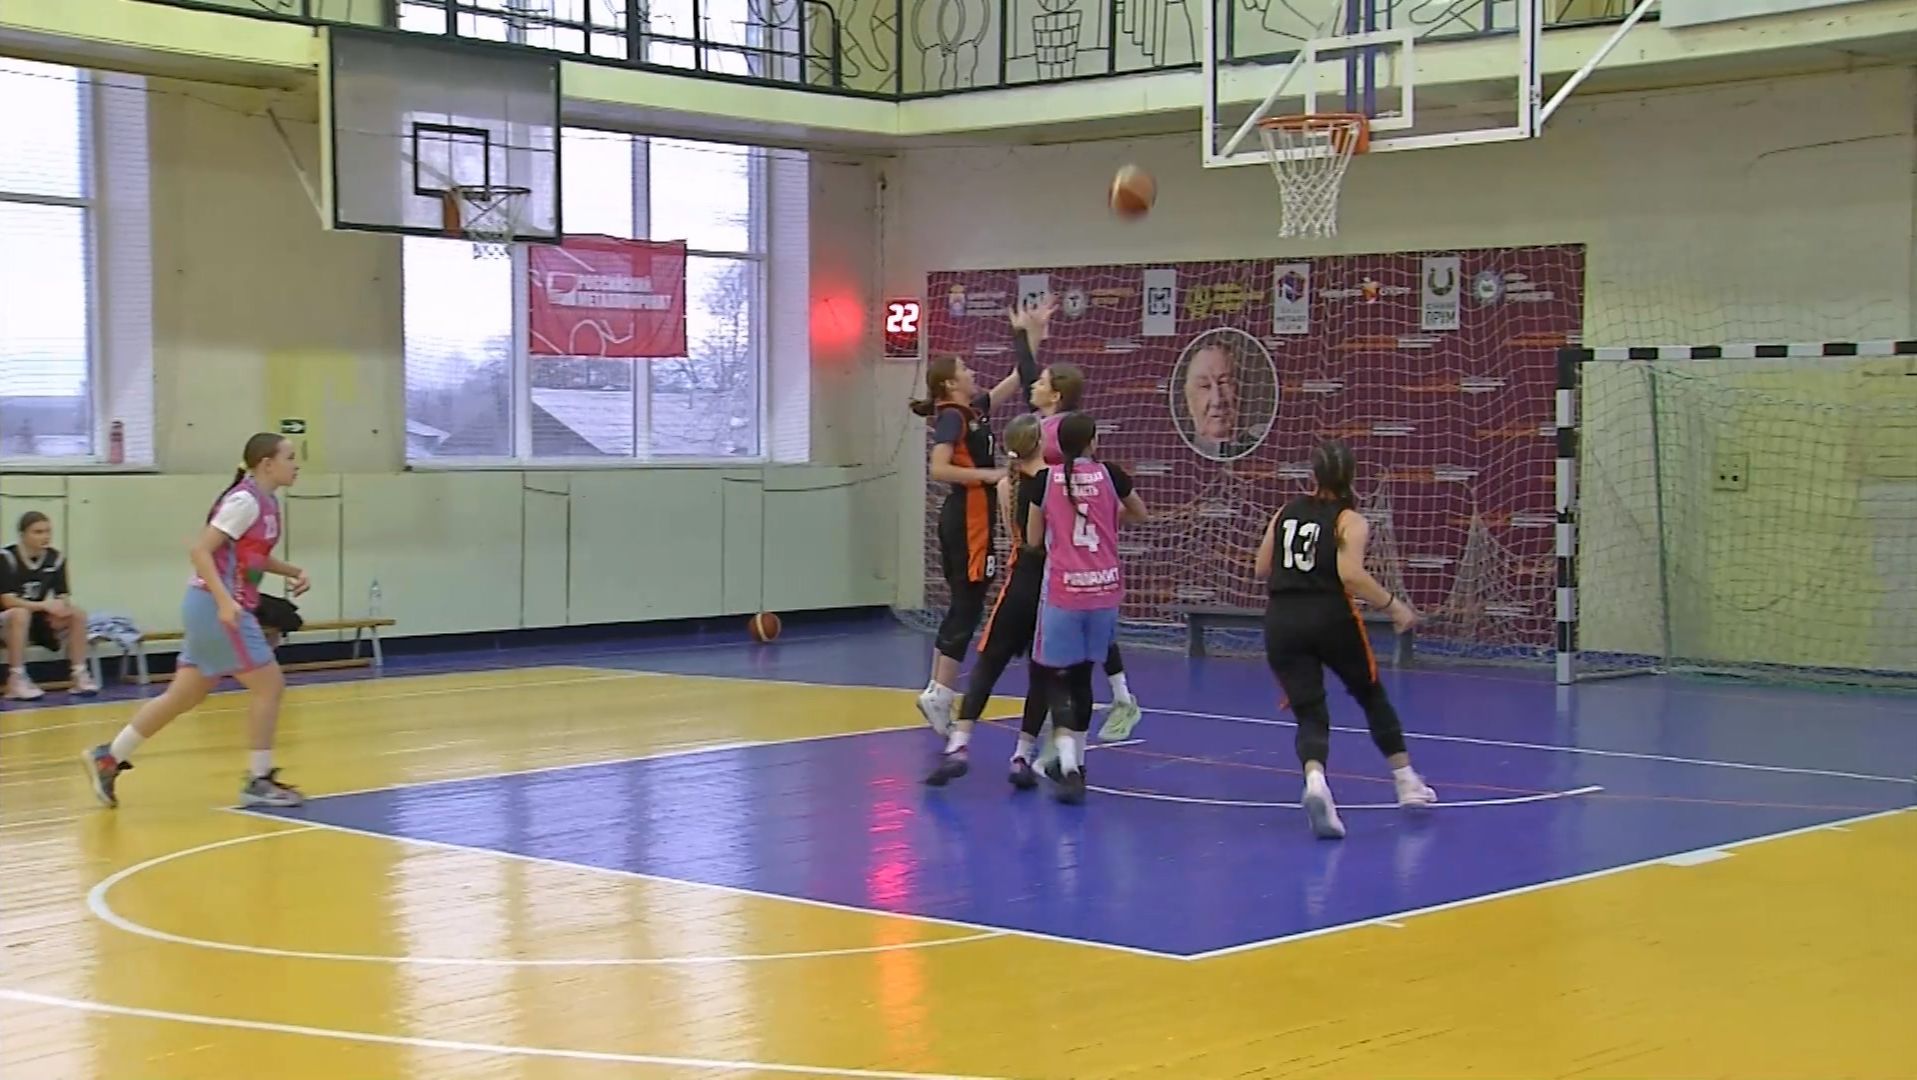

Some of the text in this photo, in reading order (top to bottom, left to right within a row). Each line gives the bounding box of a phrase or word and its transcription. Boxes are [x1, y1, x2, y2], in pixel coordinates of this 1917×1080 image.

[886, 303, 919, 332] 22
[1072, 503, 1100, 553] 4
[1282, 519, 1320, 572] 13
